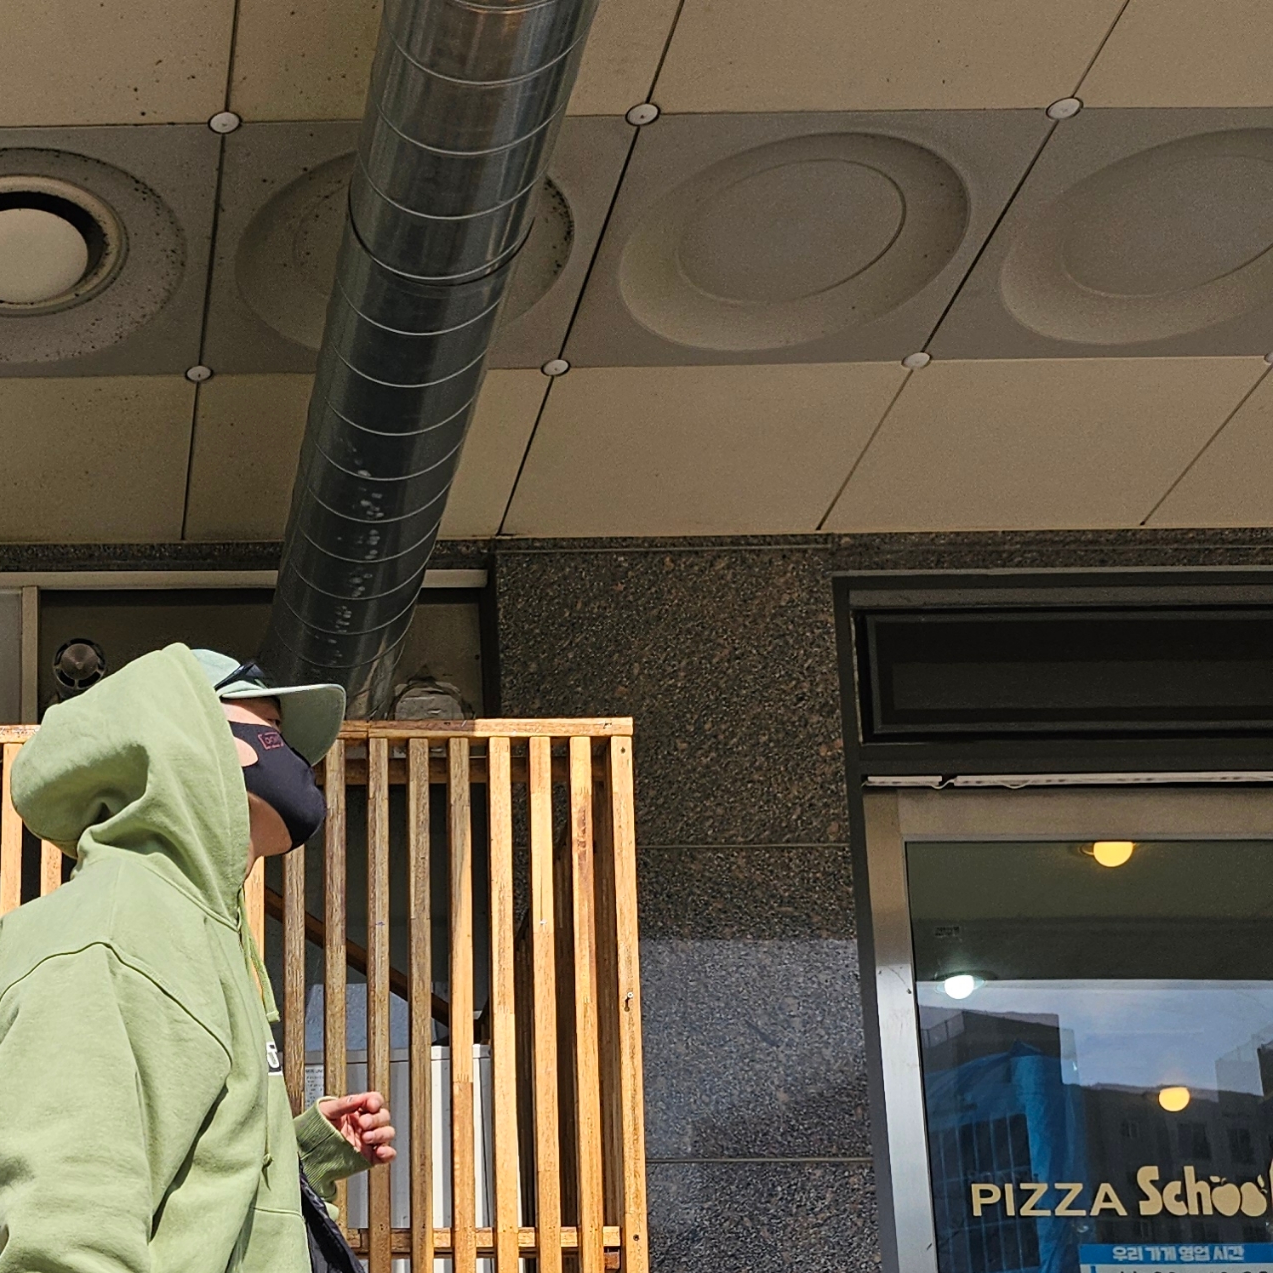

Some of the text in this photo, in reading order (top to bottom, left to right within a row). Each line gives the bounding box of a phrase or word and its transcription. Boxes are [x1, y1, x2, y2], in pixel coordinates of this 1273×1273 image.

[971, 1158, 1273, 1217] PIZZA Schoo
[1112, 1246, 1244, 1262] 우리 가게 영업 시간
